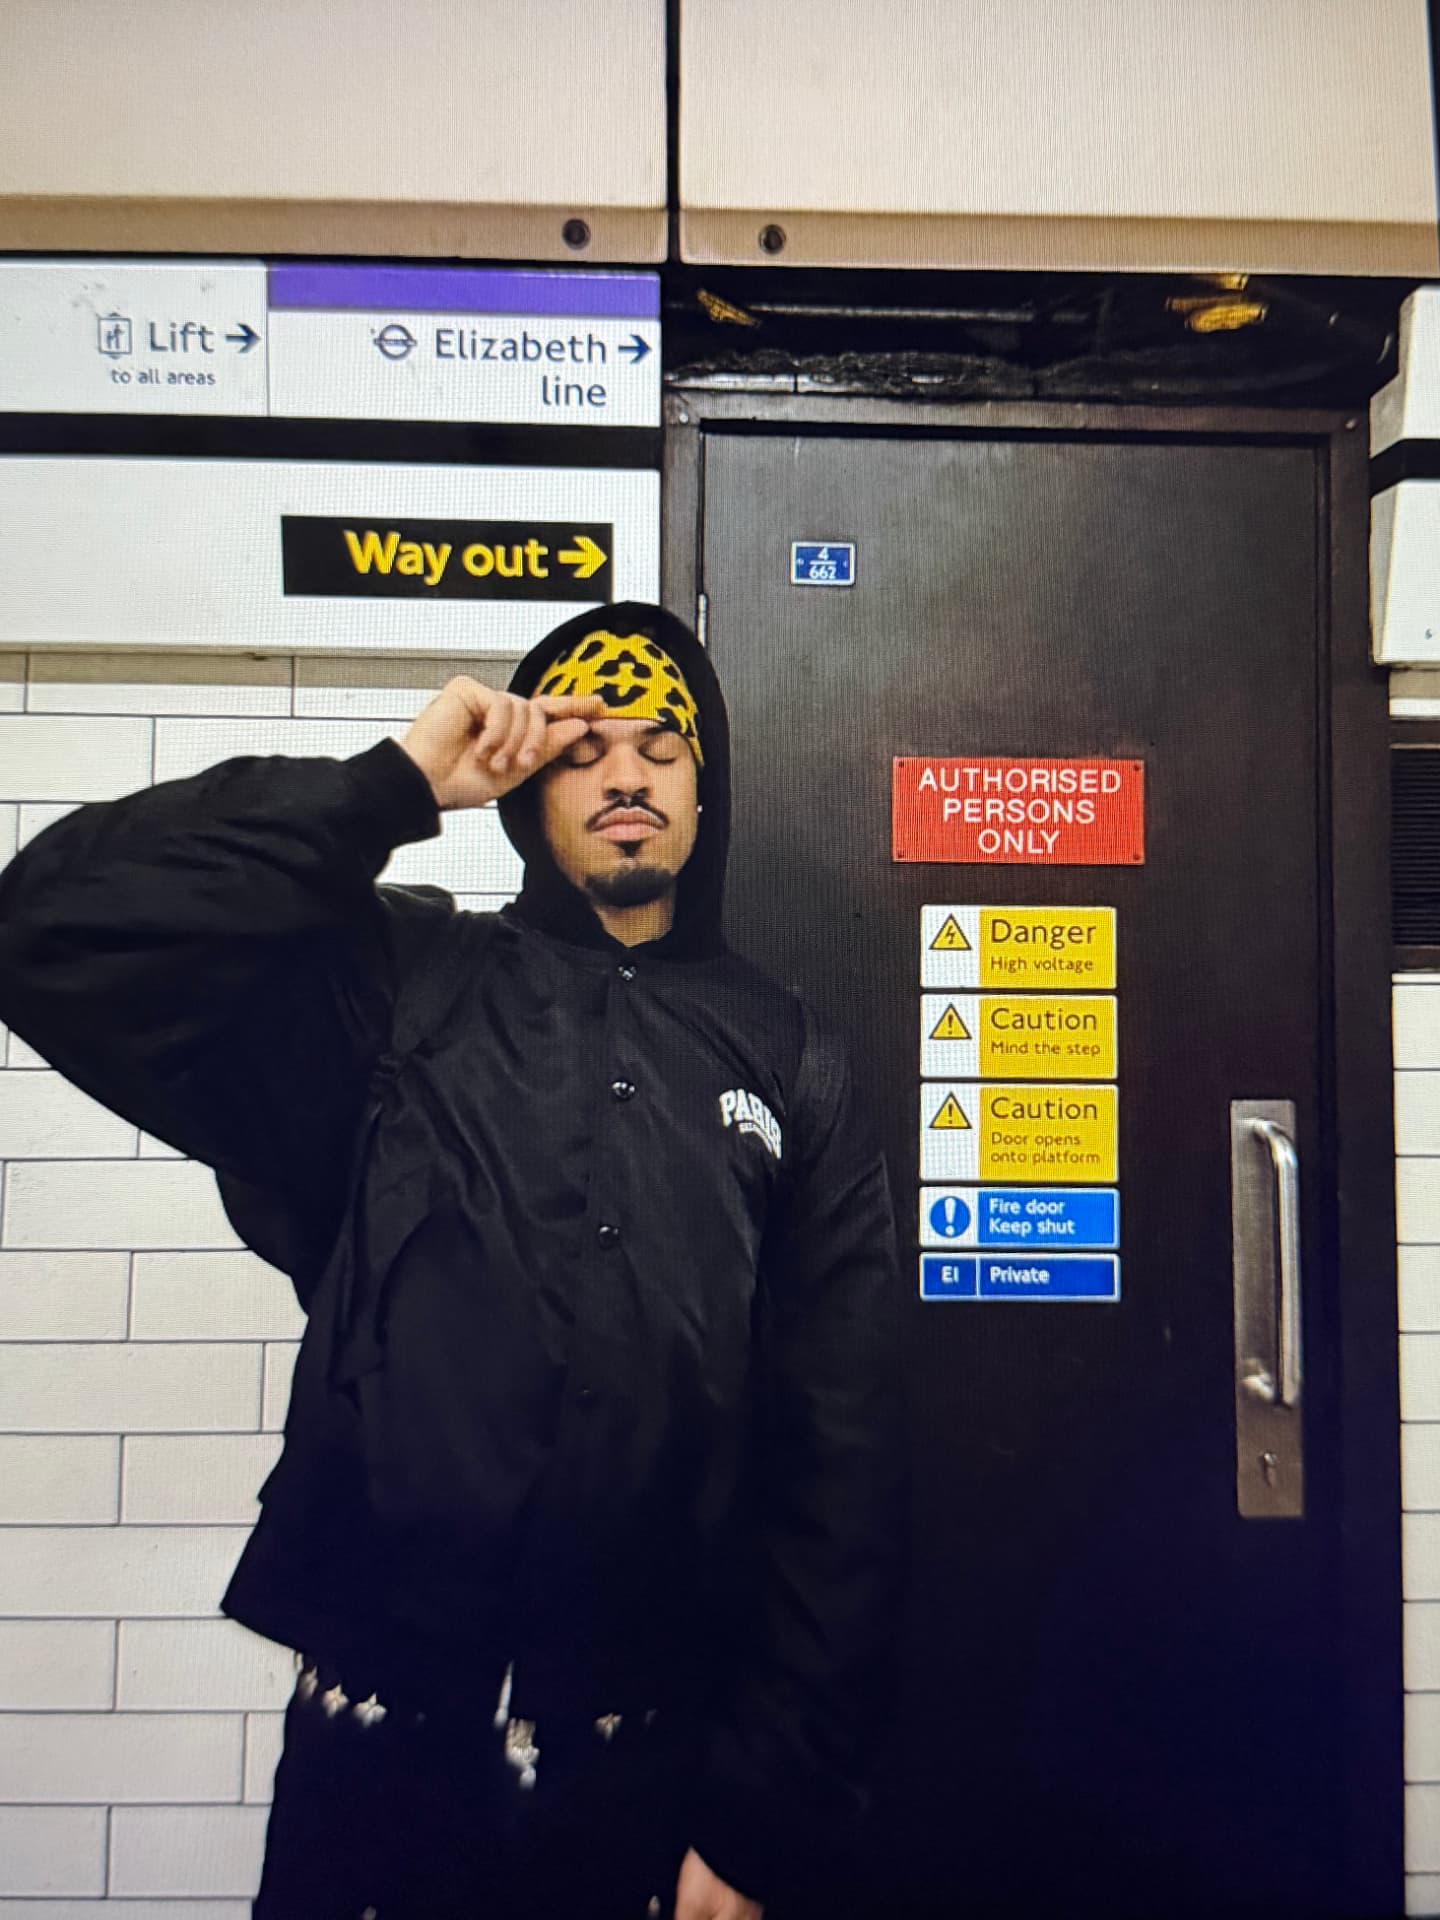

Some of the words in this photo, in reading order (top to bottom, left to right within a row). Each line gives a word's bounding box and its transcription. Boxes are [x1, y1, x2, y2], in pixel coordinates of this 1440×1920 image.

[149, 321, 215, 353] Lift
[435, 328, 607, 364] Elizabeth
[111, 369, 132, 385] to
[138, 369, 161, 385] all
[167, 372, 217, 386] areas
[541, 375, 607, 407] line
[343, 529, 452, 586] Way
[462, 538, 549, 578] out
[817, 547, 830, 560] 4
[809, 565, 837, 580] 662
[918, 767, 1122, 794] AUTHORISED
[943, 798, 1096, 824] PERSONS
[978, 829, 1061, 854] ONLY
[990, 918, 1097, 950] Danger
[990, 956, 1028, 973] High
[1033, 957, 1094, 974] voltage
[990, 1007, 1098, 1031] Caution
[990, 1041, 1029, 1055] Mind
[1034, 1042, 1061, 1055] the
[1066, 1043, 1100, 1057] step
[990, 1096, 1099, 1121] Caution
[991, 1131, 1028, 1145] Door
[1034, 1134, 1081, 1148] opens
[991, 1151, 1027, 1163] onto
[1032, 1150, 1101, 1165] platform
[989, 1197, 1021, 1215] Fire
[1025, 1199, 1065, 1215] door
[989, 1217, 1032, 1238] Keep
[1037, 1218, 1076, 1235] shut
[989, 1266, 1050, 1284] Private
